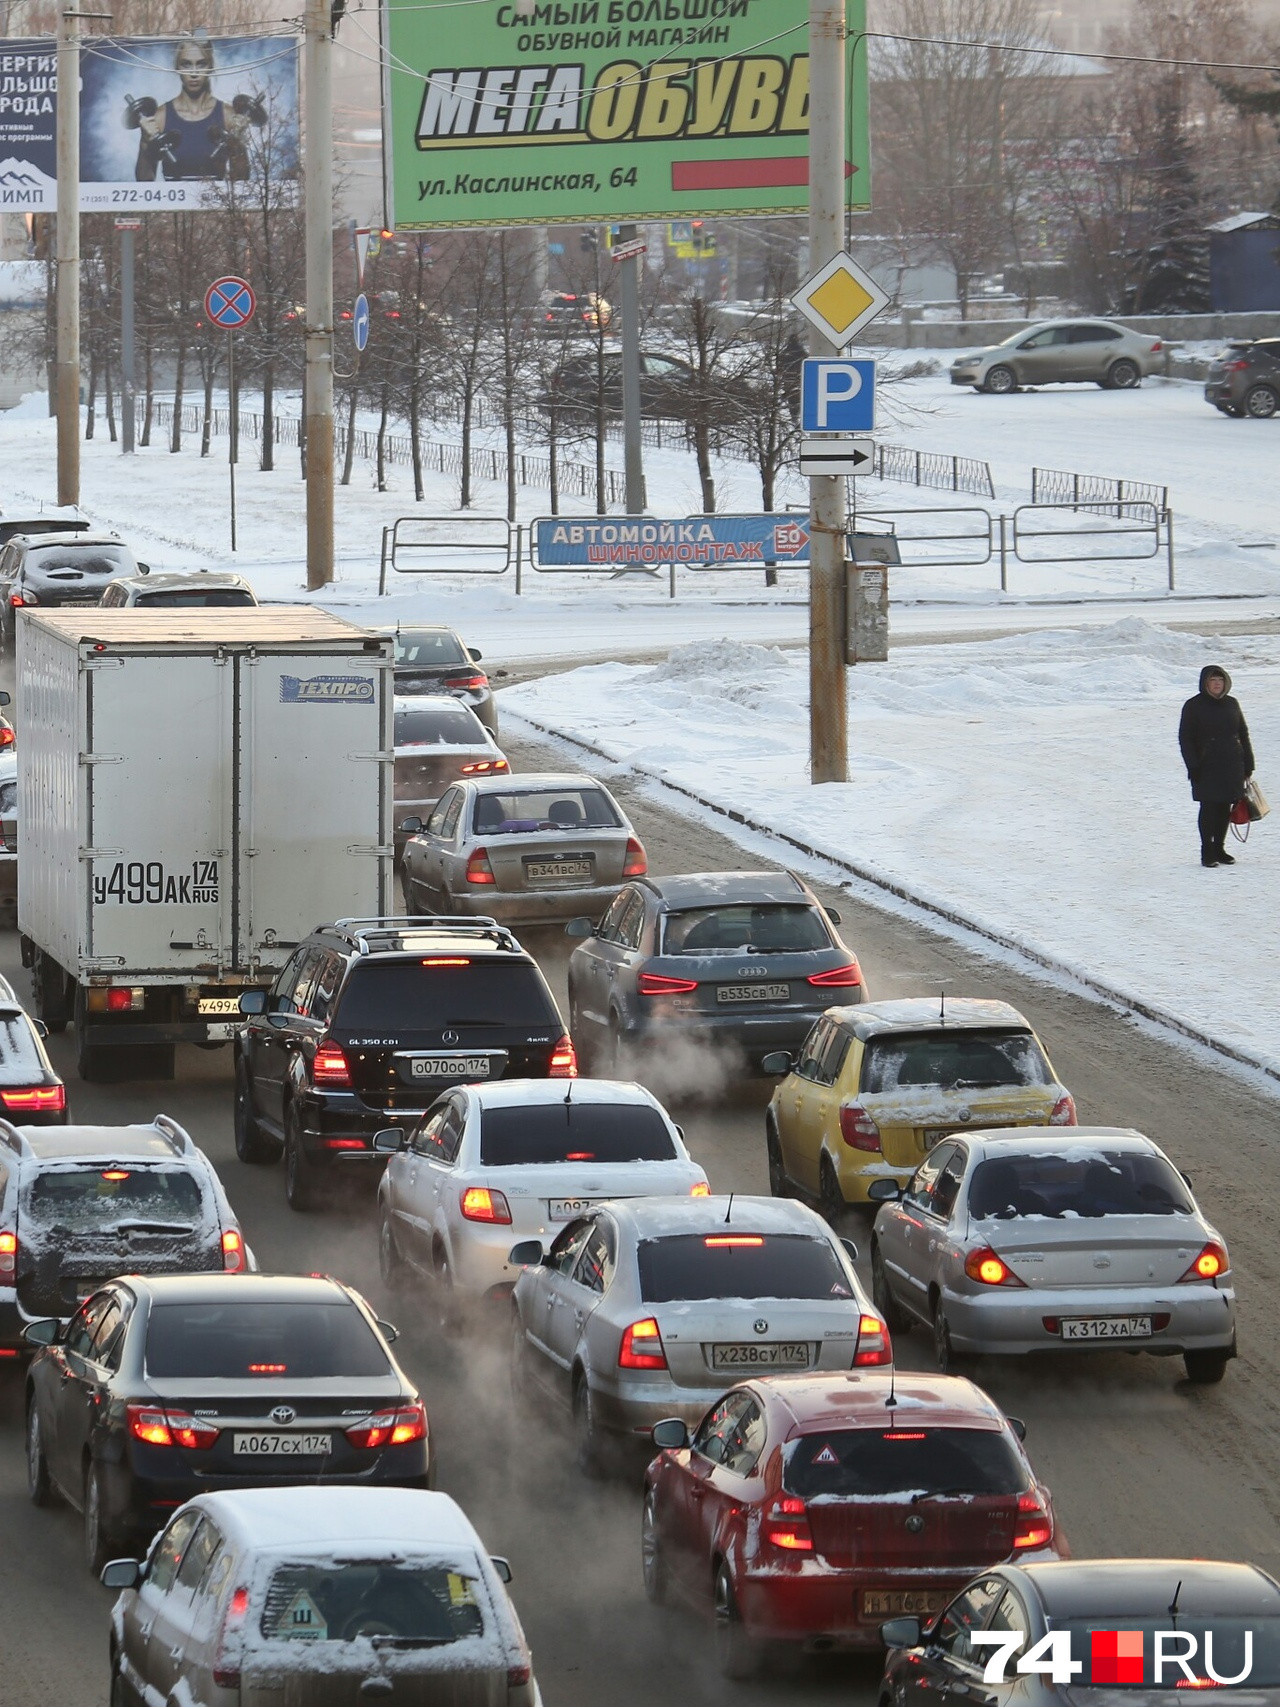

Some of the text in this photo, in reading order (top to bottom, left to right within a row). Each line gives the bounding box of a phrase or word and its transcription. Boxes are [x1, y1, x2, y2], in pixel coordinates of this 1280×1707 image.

[495, 0, 748, 28] САМЫЙ БОЛЬШОЙ
[516, 24, 730, 52] ОБУВНОЙ МАГАЗИН
[7, 133, 53, 143] программы
[417, 166, 638, 201] ул.Каслинская, 64
[111, 190, 187, 203] 272-04-03
[552, 520, 716, 545] АВТОМОЙКА
[777, 529, 800, 544] 50
[588, 541, 764, 564] ШИНОМОНТАЖ
[192, 861, 219, 885] 174
[192, 890, 219, 903] RUS
[720, 987, 766, 1001] В535СВ
[348, 1037, 400, 1046] GL 350 CDI
[467, 1058, 488, 1070] 174
[1068, 1317, 1147, 1337] К312ХА 74
[718, 1343, 805, 1363] Х238СУ 174
[238, 1435, 329, 1454] А067СХ 174
[293, 1608, 312, 1624] Ш
